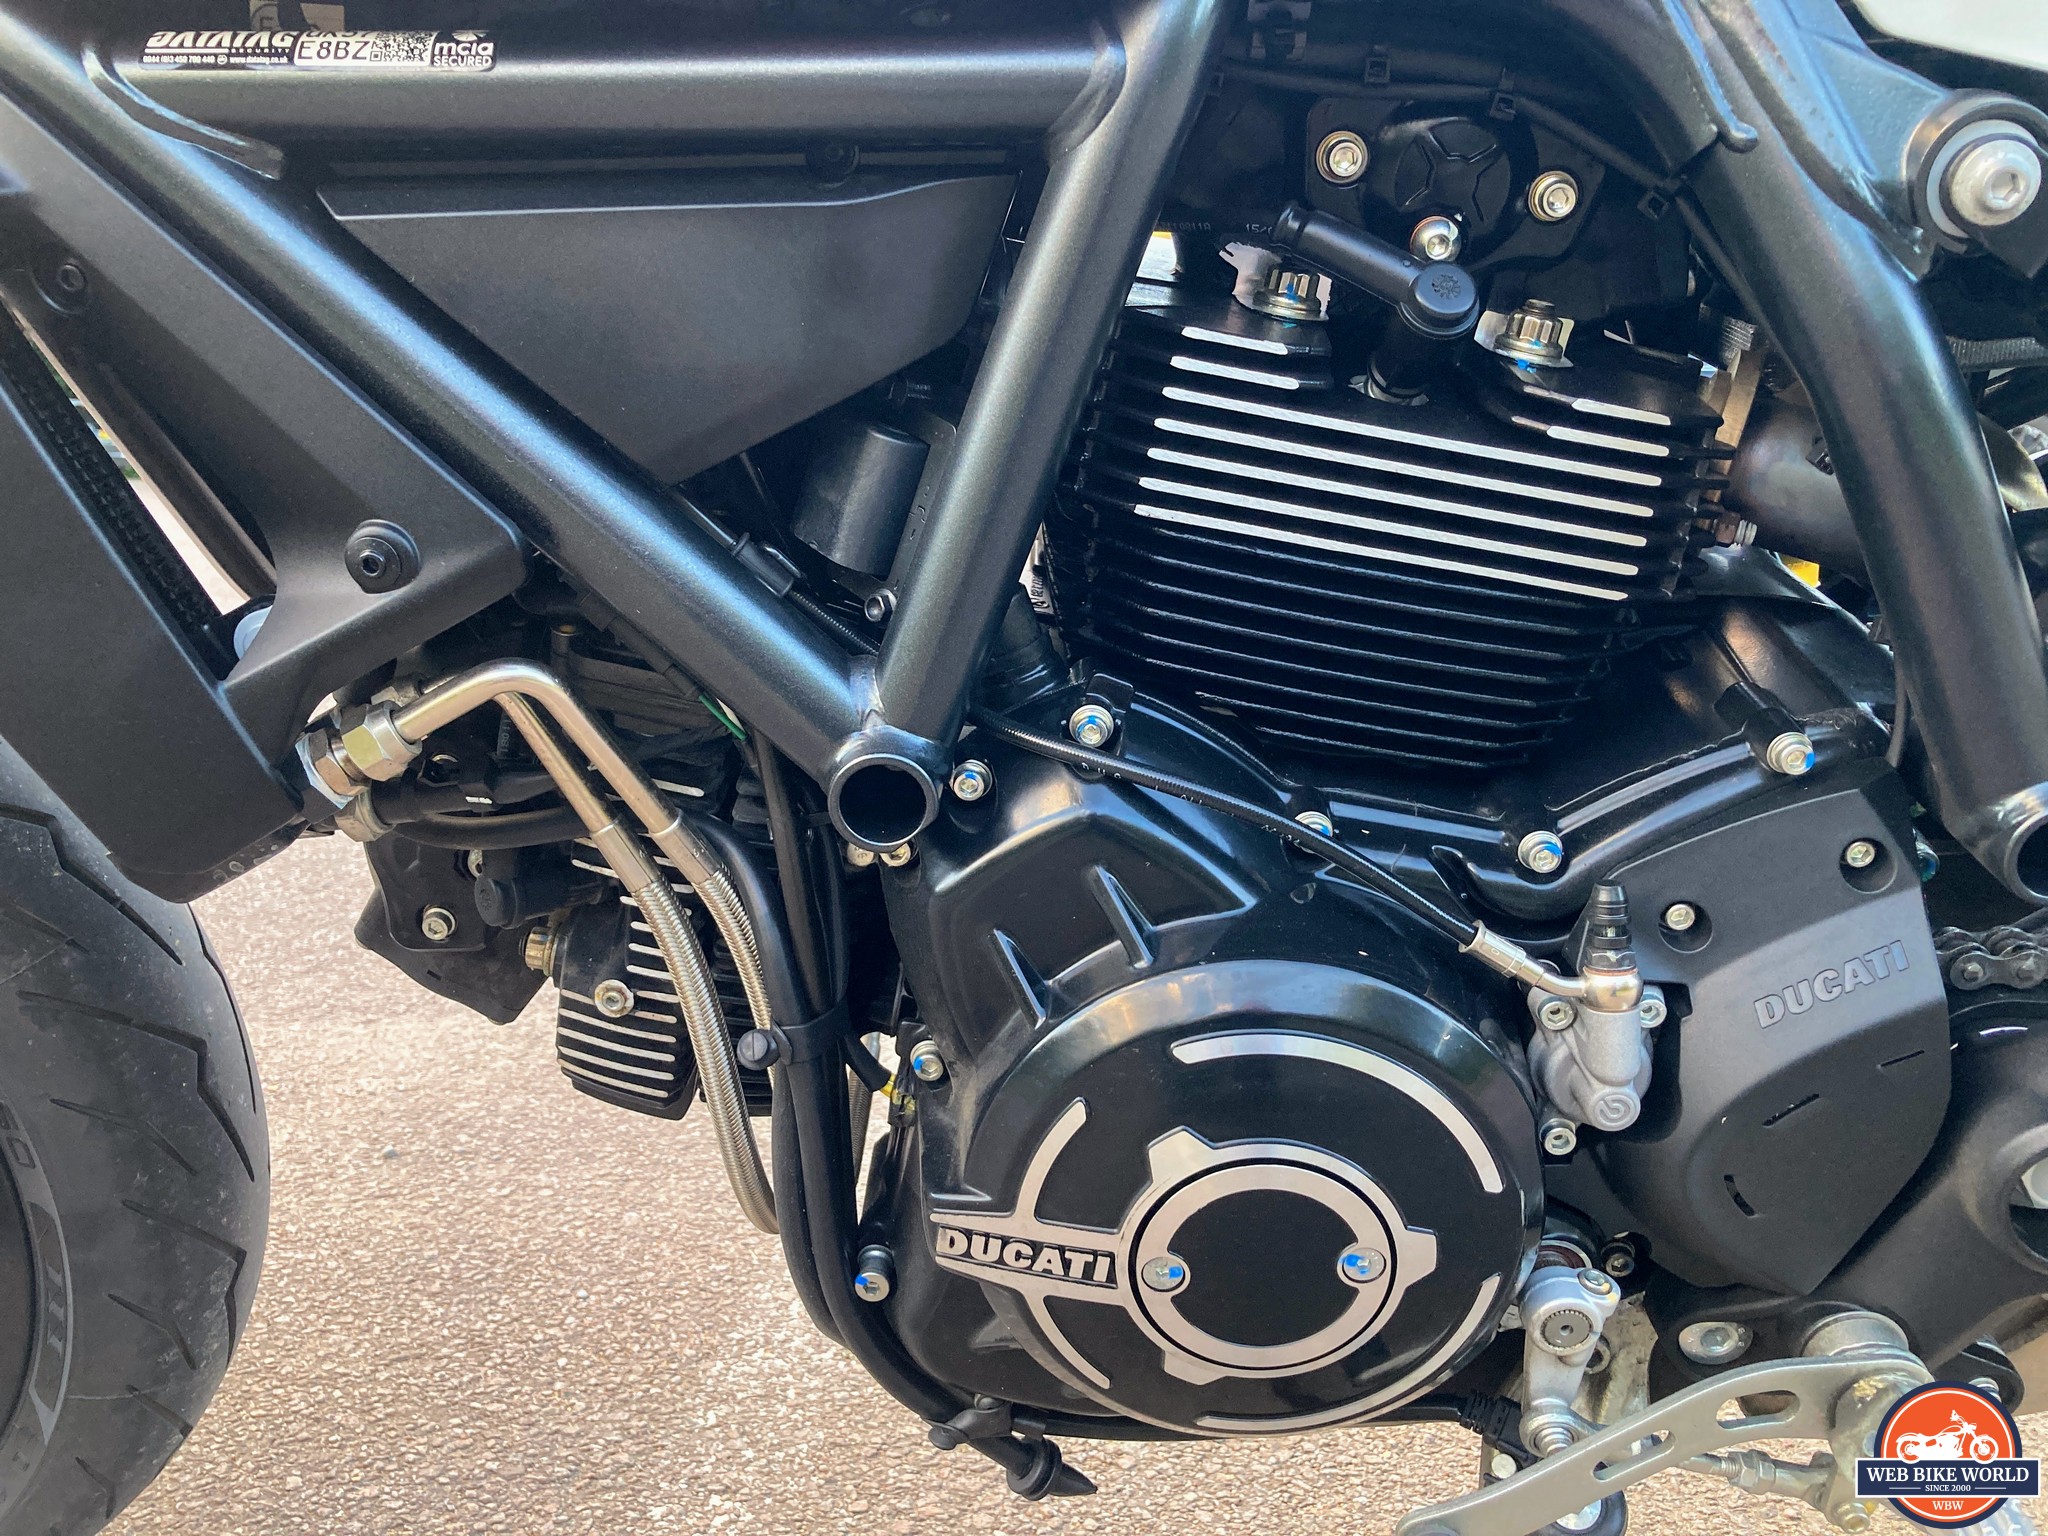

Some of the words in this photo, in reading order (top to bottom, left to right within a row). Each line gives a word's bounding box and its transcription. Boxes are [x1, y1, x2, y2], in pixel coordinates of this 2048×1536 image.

[146, 31, 298, 47] DATATAG
[297, 40, 370, 60] E8BZ
[434, 41, 494, 56] mcia
[433, 56, 492, 67] SECURED
[1753, 940, 1910, 1029] DUCATI
[935, 1226, 1111, 1283] DUCATI
